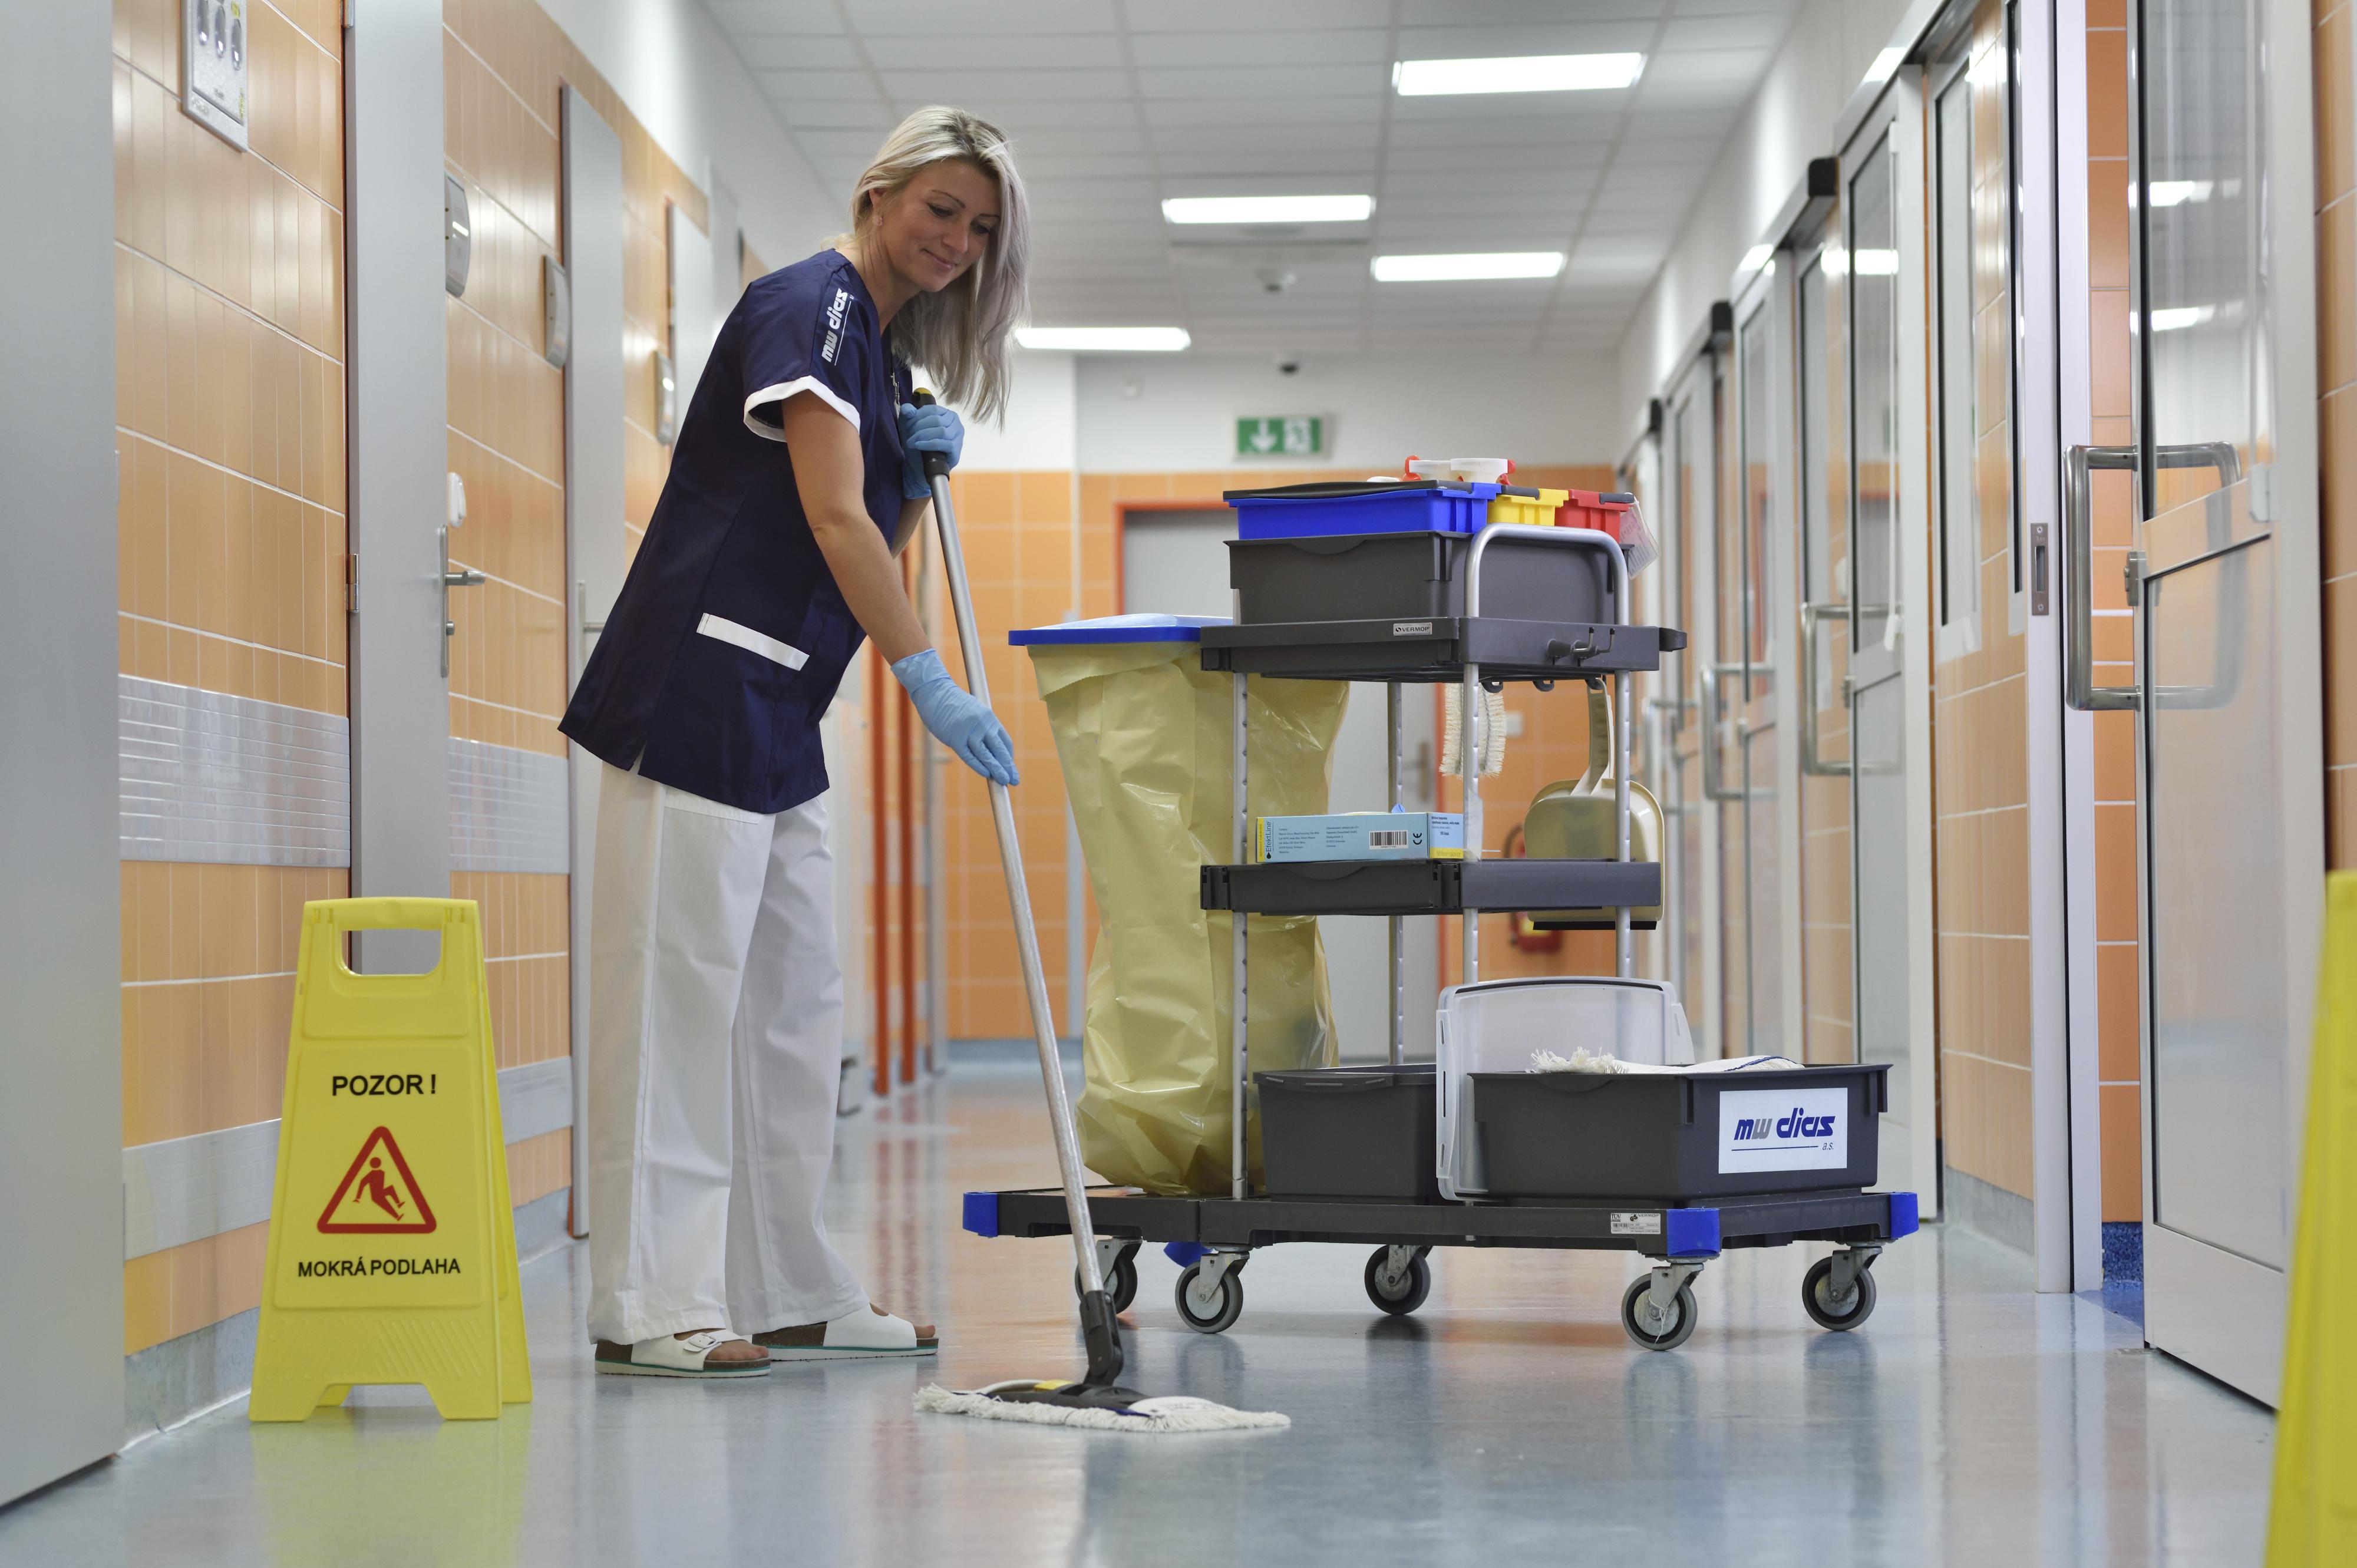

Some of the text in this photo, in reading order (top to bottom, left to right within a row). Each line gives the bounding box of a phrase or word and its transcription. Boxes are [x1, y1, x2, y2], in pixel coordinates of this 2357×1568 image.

[821, 288, 848, 363] mw dias
[331, 1074, 424, 1096] POZOR
[1734, 1107, 1836, 1141] mw dias
[1822, 1142, 1834, 1150] a.s.
[298, 1256, 461, 1277] MOKRÁ PODLAHA
